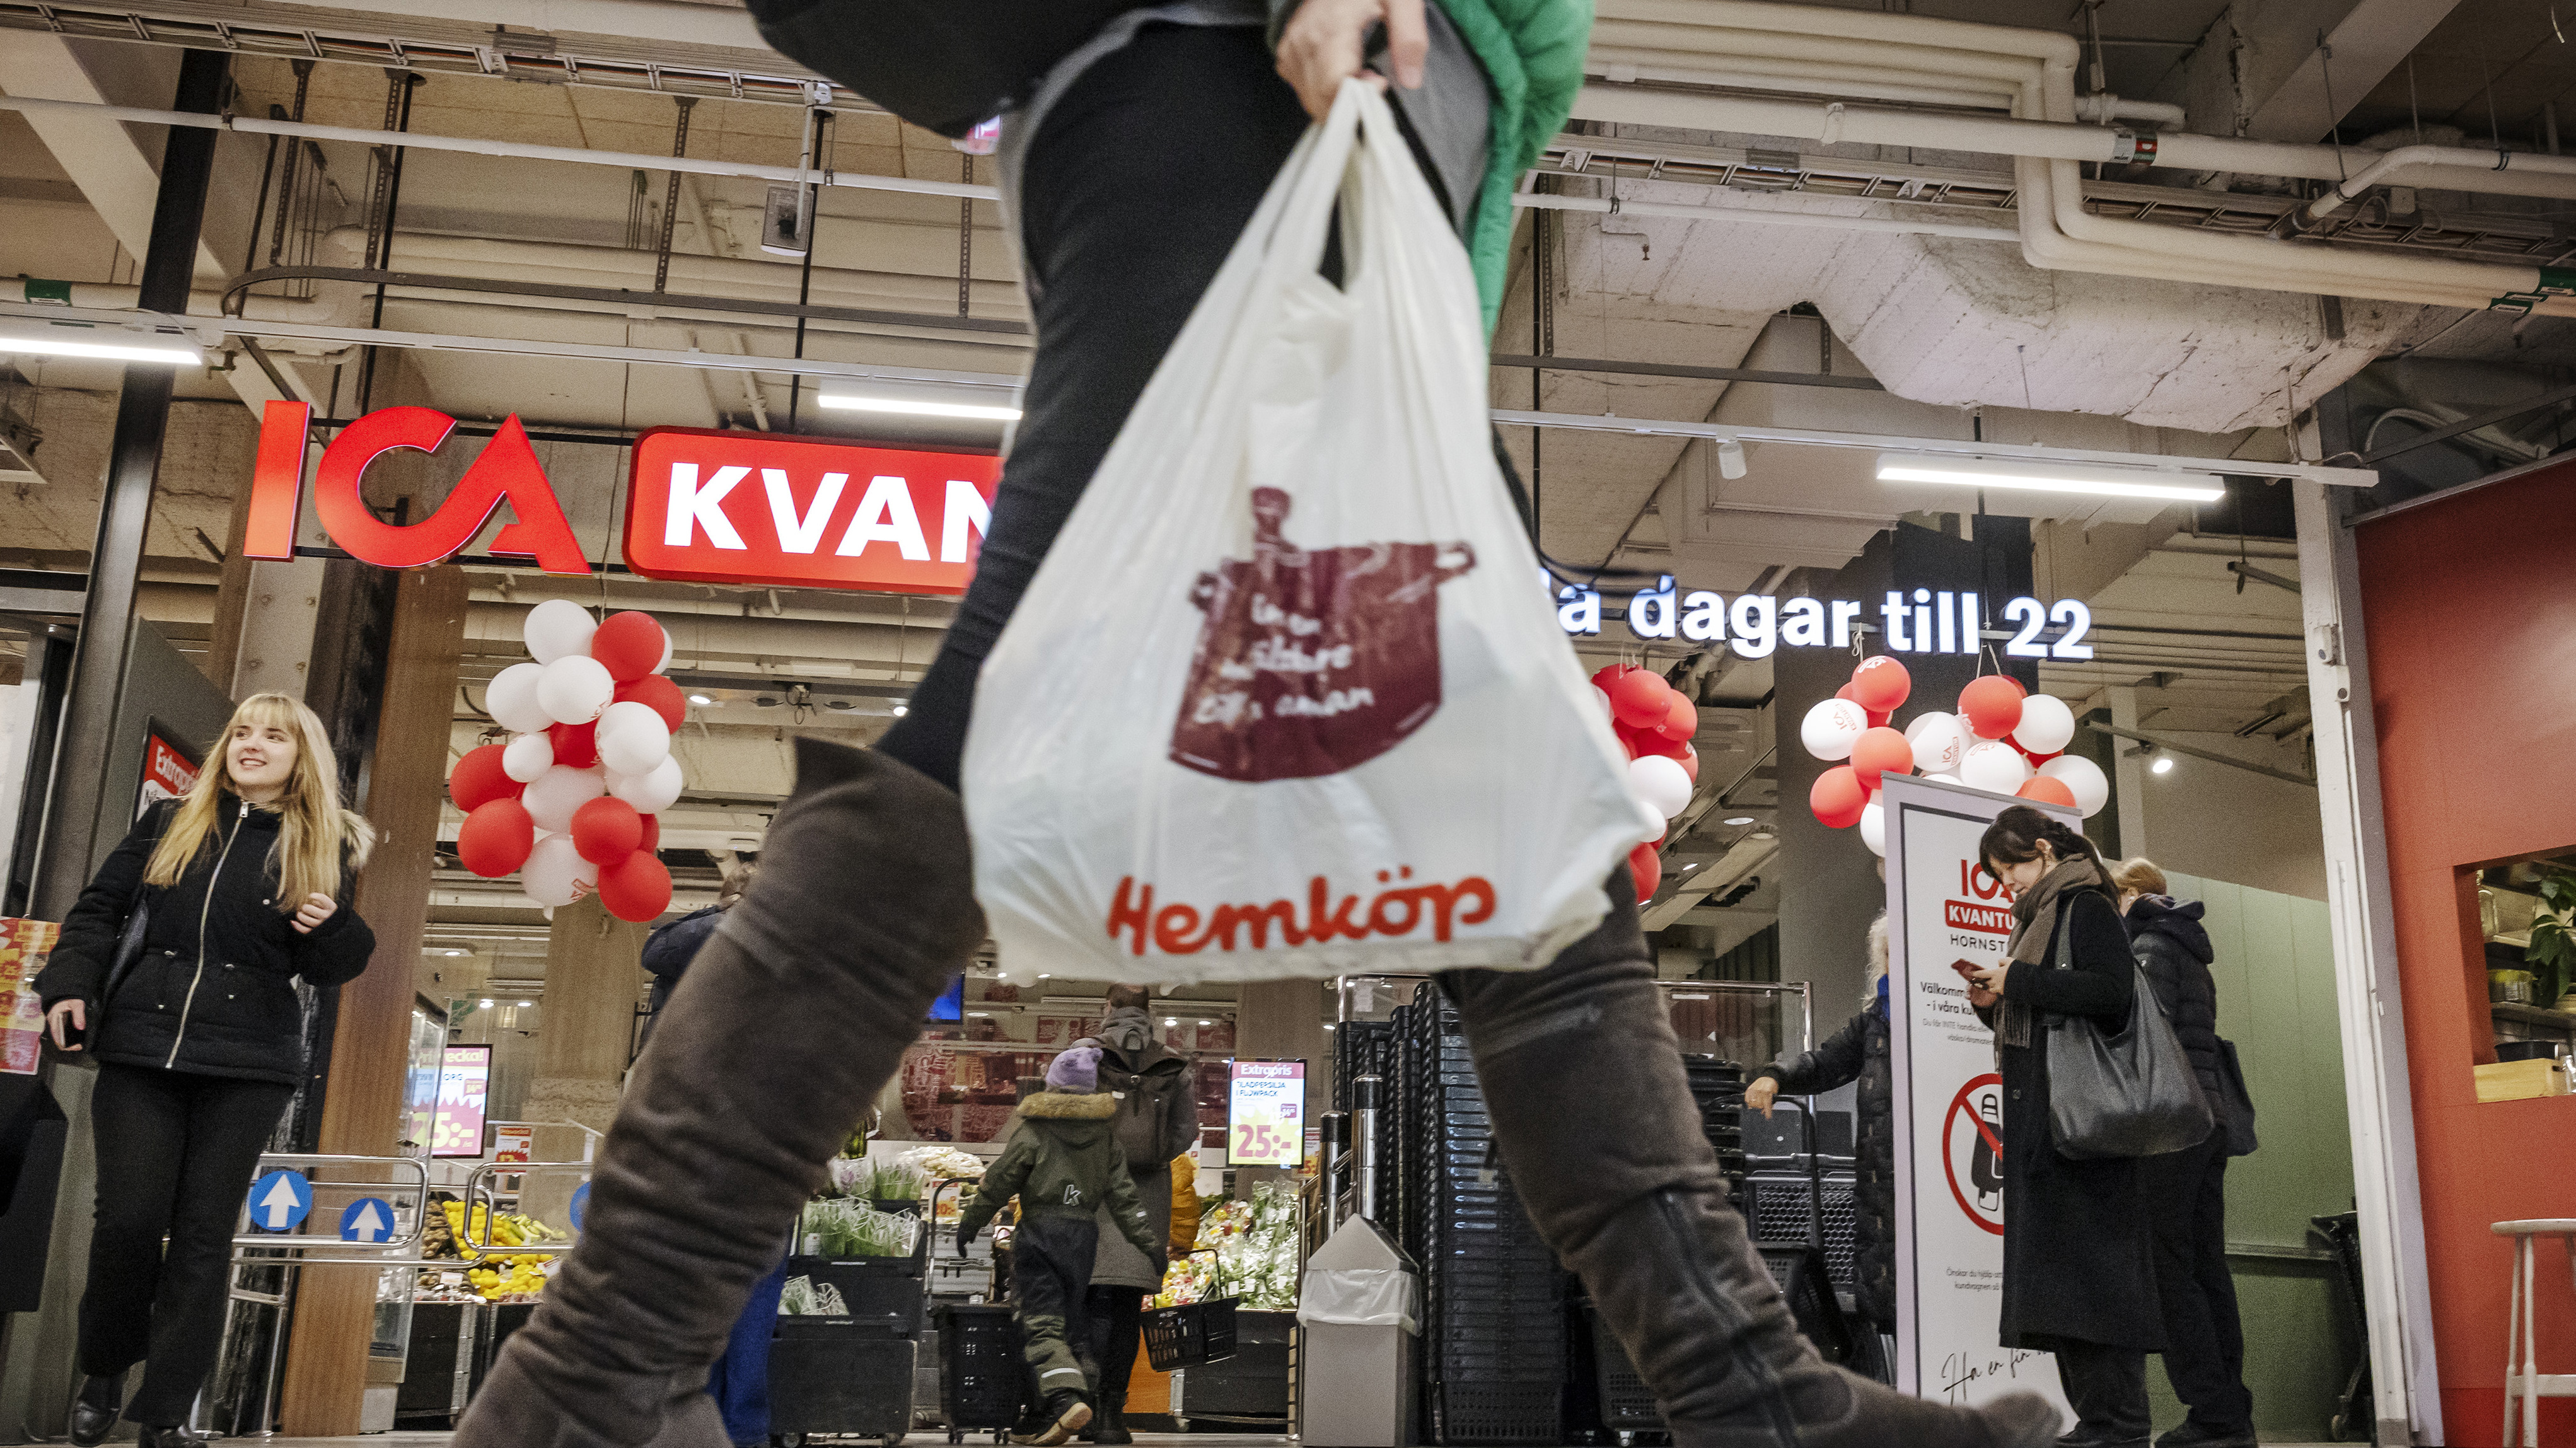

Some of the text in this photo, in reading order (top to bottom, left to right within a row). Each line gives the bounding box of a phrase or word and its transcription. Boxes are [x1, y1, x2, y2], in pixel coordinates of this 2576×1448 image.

[243, 400, 593, 575] ICA
[664, 461, 993, 563] KVAN
[1629, 575, 1861, 659] dagar
[1881, 588, 1980, 654] till
[2005, 596, 2094, 659] 22
[1108, 866, 1497, 956] Hemköp
[1949, 905, 2016, 930] KVANTU
[1950, 934, 2005, 952] HORNST
[1920, 981, 1966, 997] Välkomm
[1240, 1063, 1292, 1078] Extrapris
[1237, 1124, 1291, 1158] 25:-
